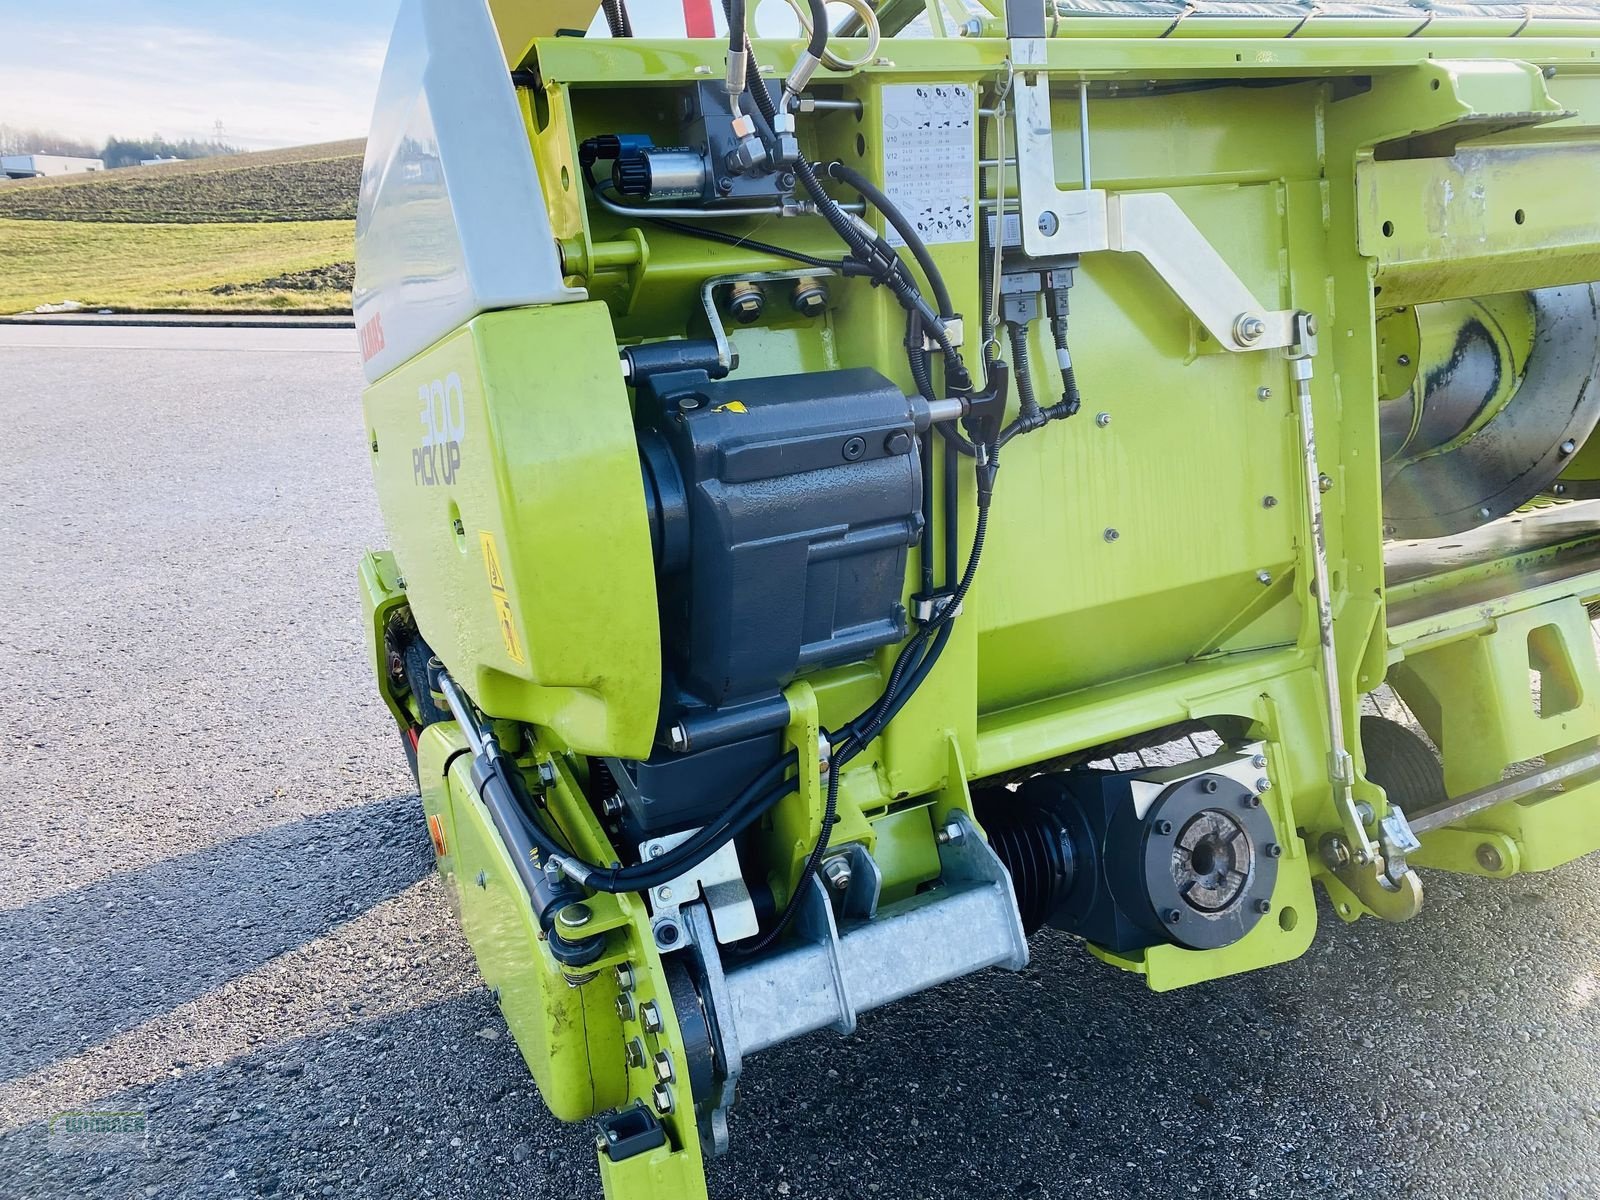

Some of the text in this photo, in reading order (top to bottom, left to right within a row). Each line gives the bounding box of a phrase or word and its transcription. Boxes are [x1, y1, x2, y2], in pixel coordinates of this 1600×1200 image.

[886, 152, 898, 160] V12
[418, 372, 465, 447] 300
[412, 440, 461, 486] PICK UP
